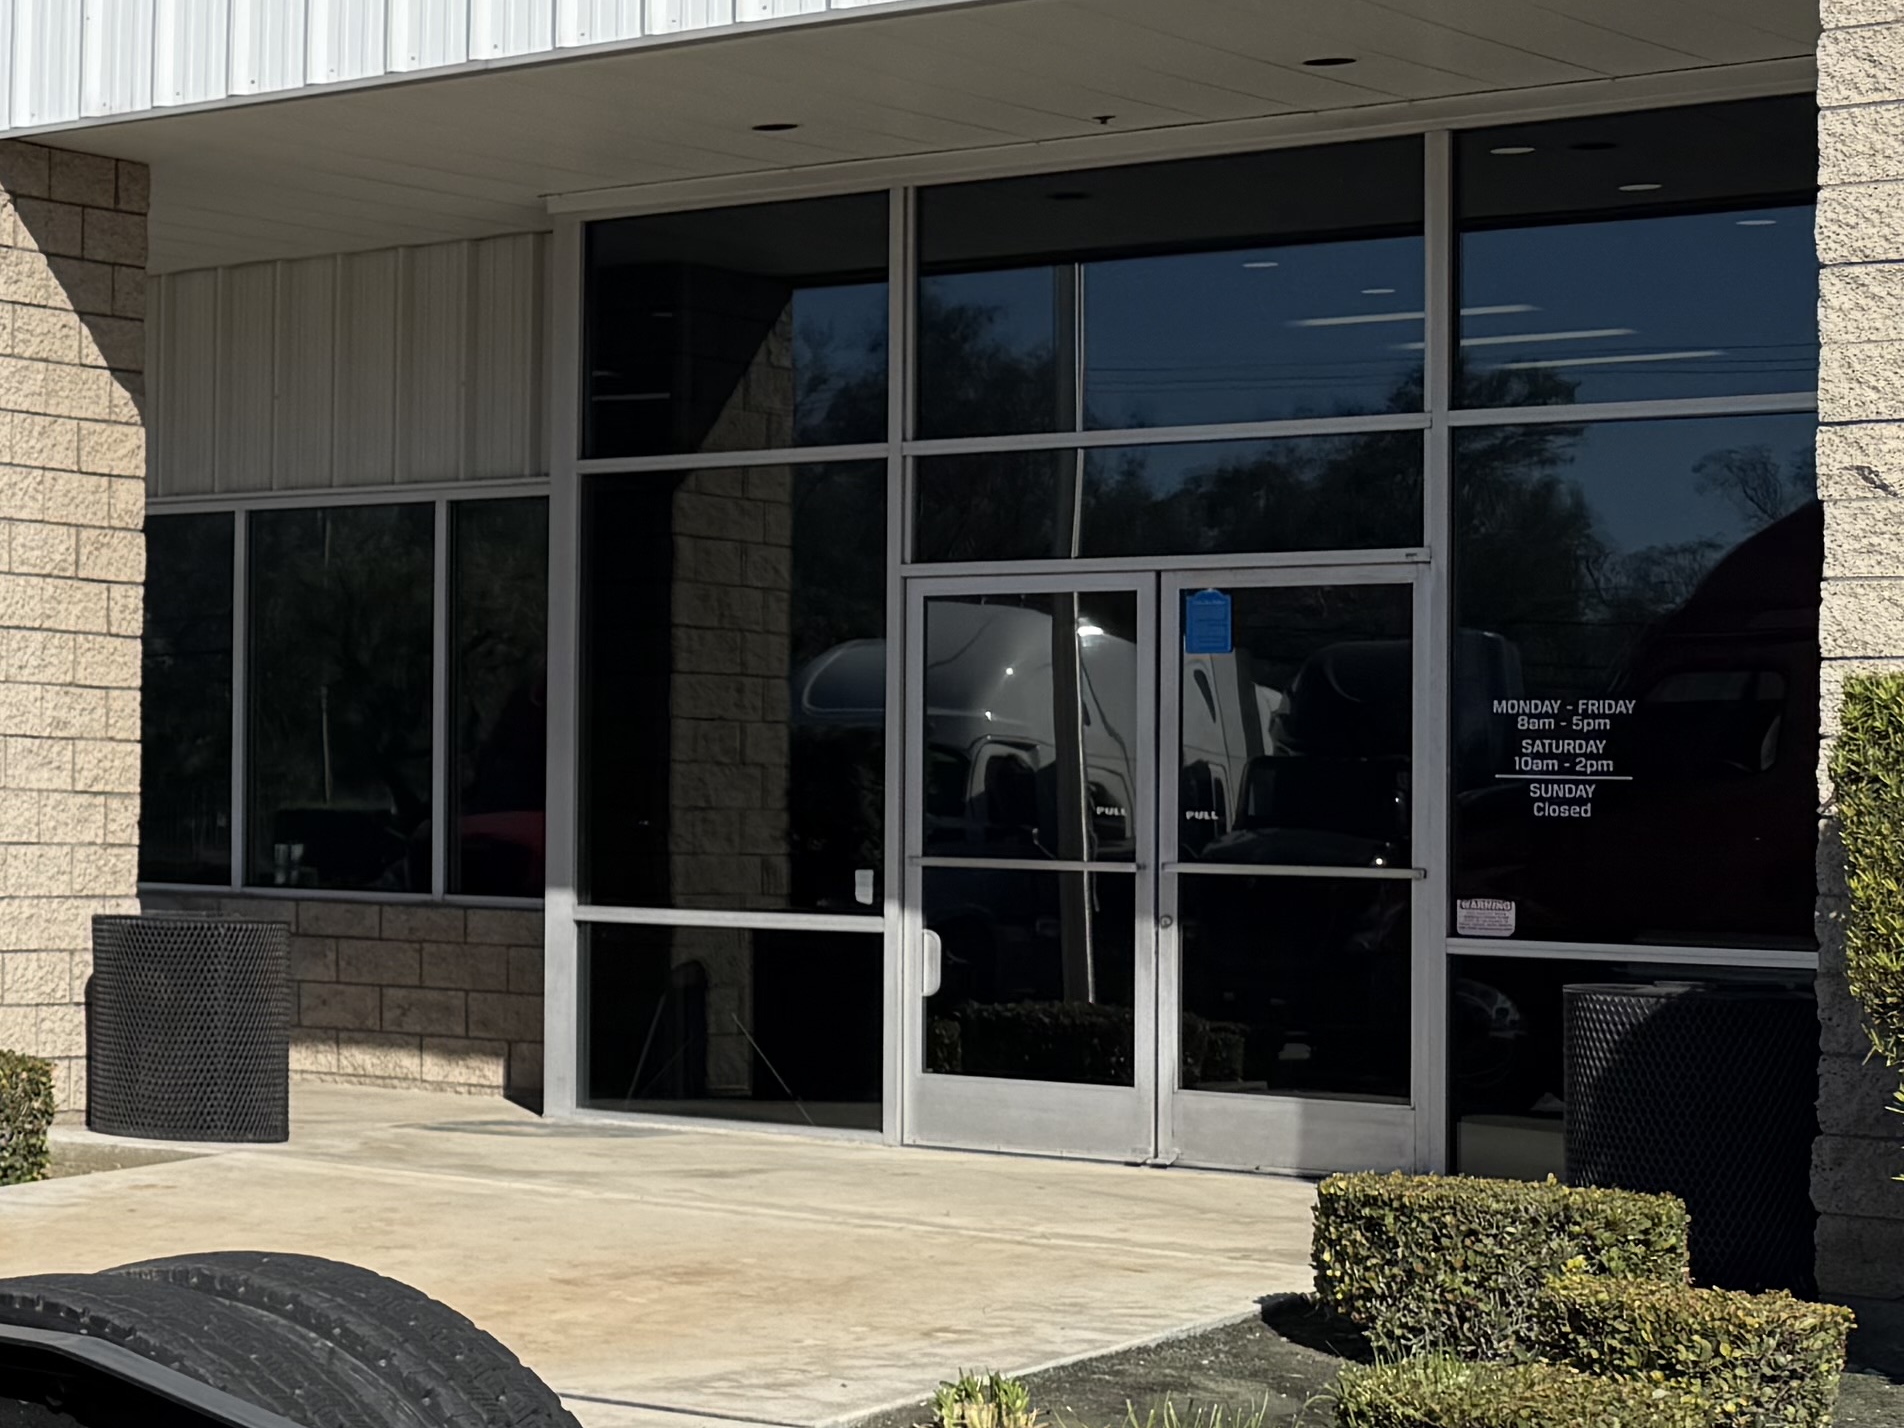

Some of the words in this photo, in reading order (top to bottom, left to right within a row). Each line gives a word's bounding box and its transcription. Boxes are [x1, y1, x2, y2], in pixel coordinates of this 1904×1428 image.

[1493, 699, 1562, 714] MONDAY
[1578, 699, 1636, 714] FRIDAY
[1517, 715, 1555, 730] 8am
[1572, 715, 1611, 732] 5pm
[1521, 739, 1607, 754] SATURDAY
[1514, 756, 1559, 771] 10am
[1575, 757, 1614, 773] 2pm
[1529, 783, 1596, 799] SUNDAY
[1096, 805, 1129, 816] PULL
[1185, 810, 1219, 820] PULL
[1533, 802, 1592, 818] Closed
